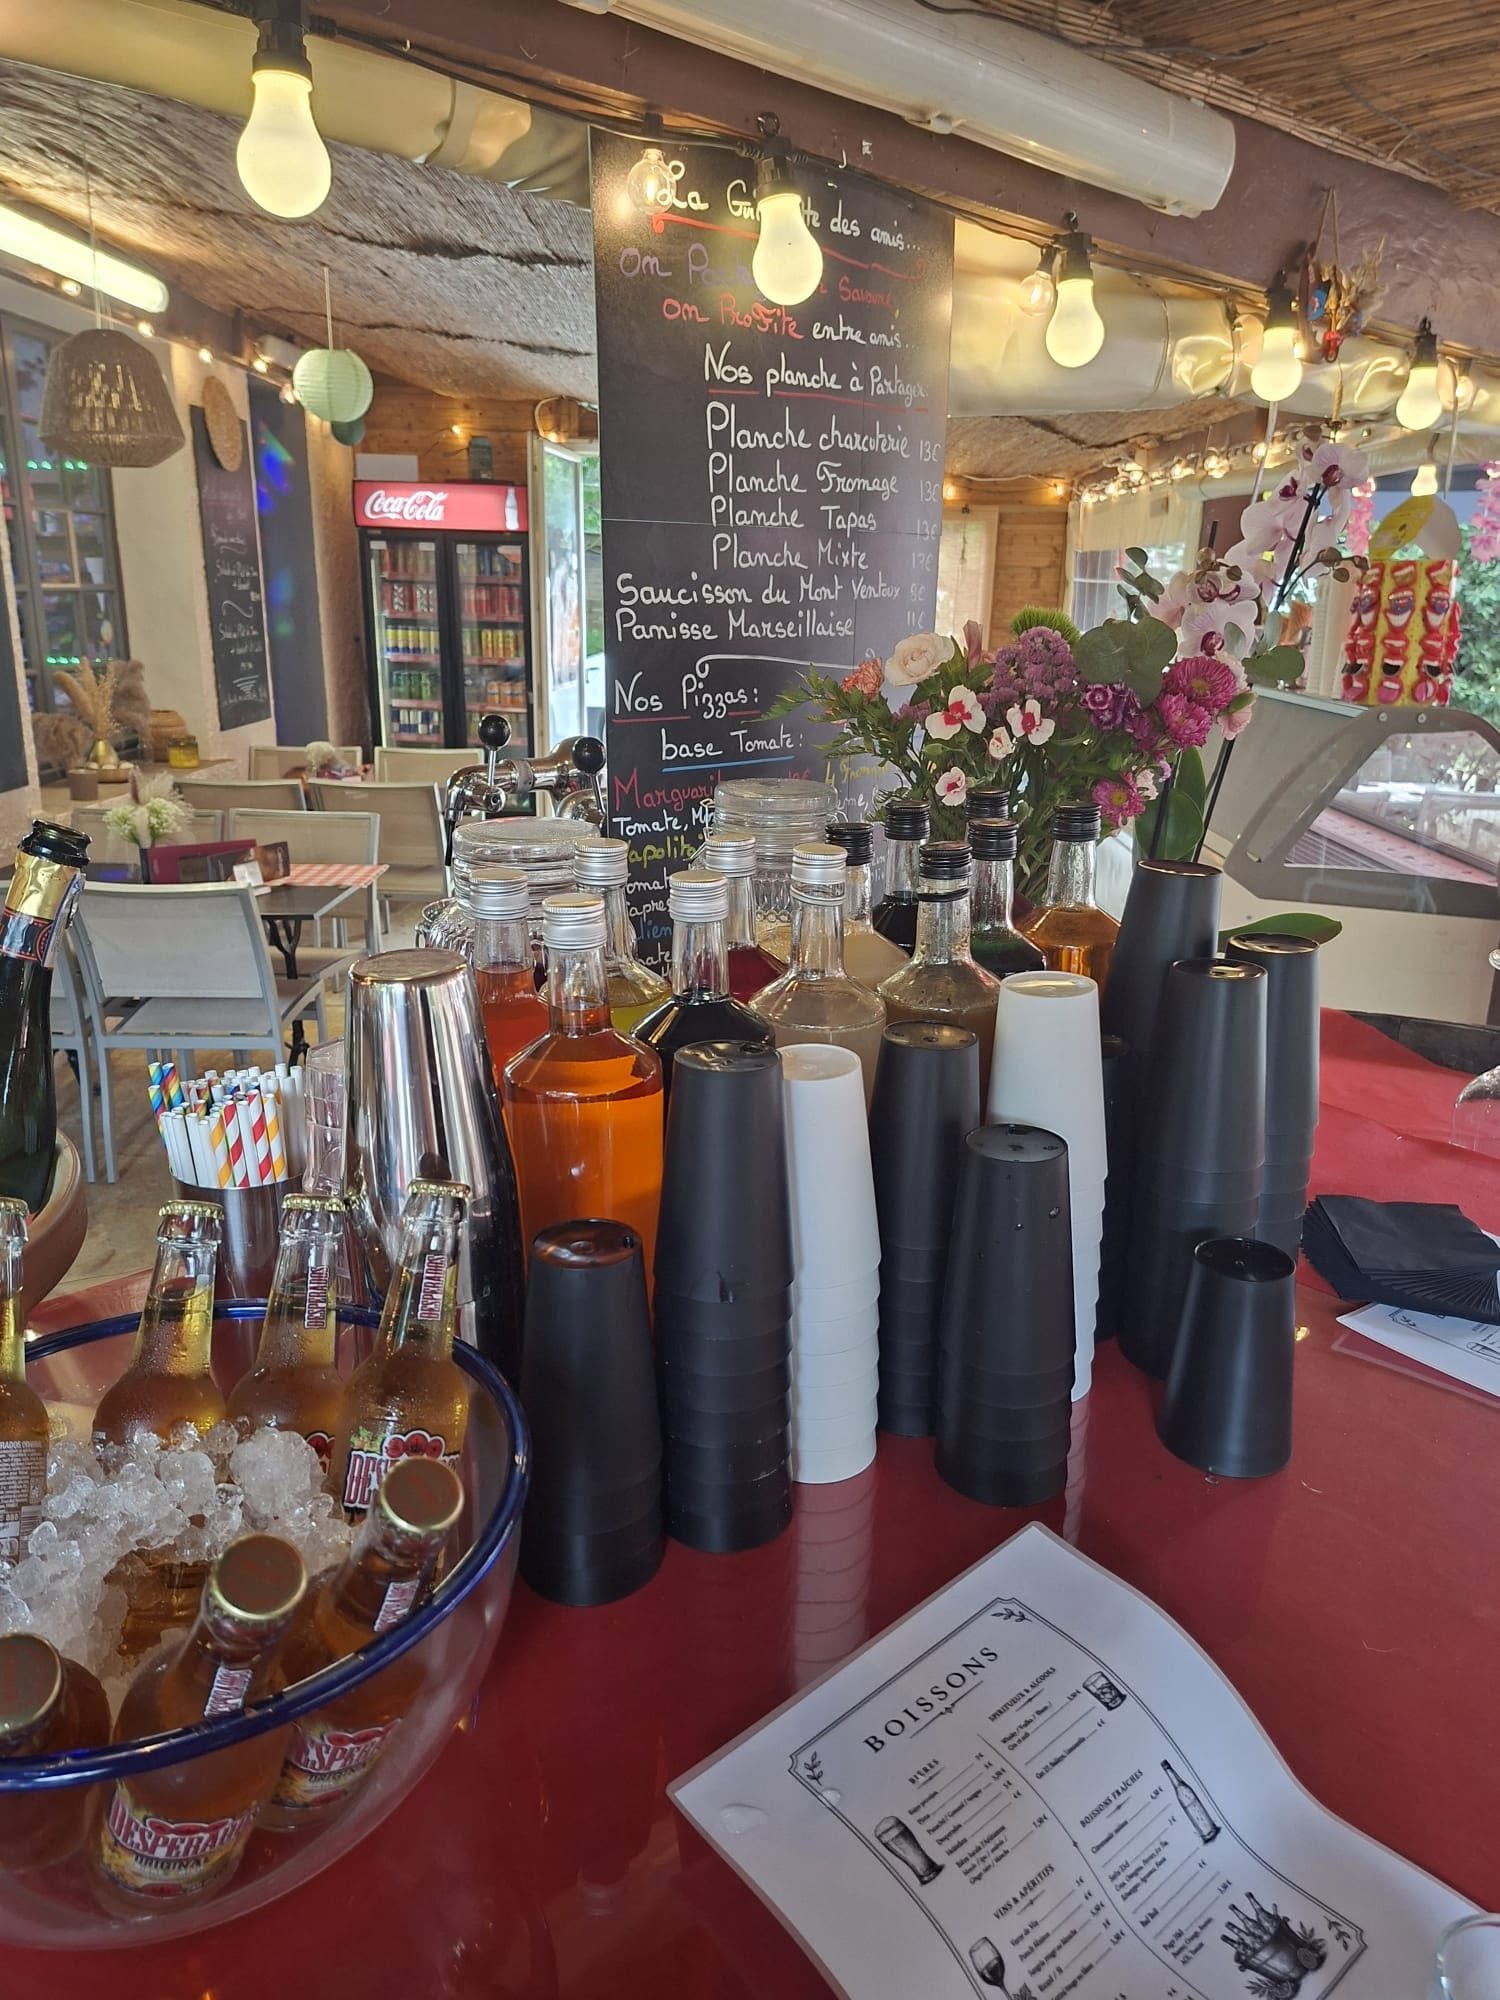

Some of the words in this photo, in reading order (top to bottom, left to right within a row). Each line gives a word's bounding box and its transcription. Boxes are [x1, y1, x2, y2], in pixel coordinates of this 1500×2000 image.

[830, 200, 860, 238] des
[812, 313, 867, 345] entre
[703, 341, 753, 384] Nos
[765, 351, 841, 398] planche
[850, 361, 864, 392] à
[706, 401, 812, 450] Planche
[708, 452, 806, 493] Planche
[816, 461, 899, 500] Fromage
[364, 490, 448, 521] Coca-Cola
[710, 495, 804, 528] Planche
[820, 505, 876, 538] Tapas
[712, 533, 807, 570] Planche
[818, 538, 868, 570] Mixte
[616, 571, 752, 605] Saucisson
[762, 574, 790, 604] du
[799, 573, 843, 602] Mont
[851, 572, 900, 601] Ventoux
[615, 607, 718, 642] Panisse
[728, 609, 854, 640] Marseillaise
[614, 671, 664, 715] Nos
[661, 729, 723, 761] base
[306, 1266, 329, 1328] DESPERADOS
[419, 1255, 448, 1320] DESPERADOS
[863, 1646, 999, 1754] BOISSONS
